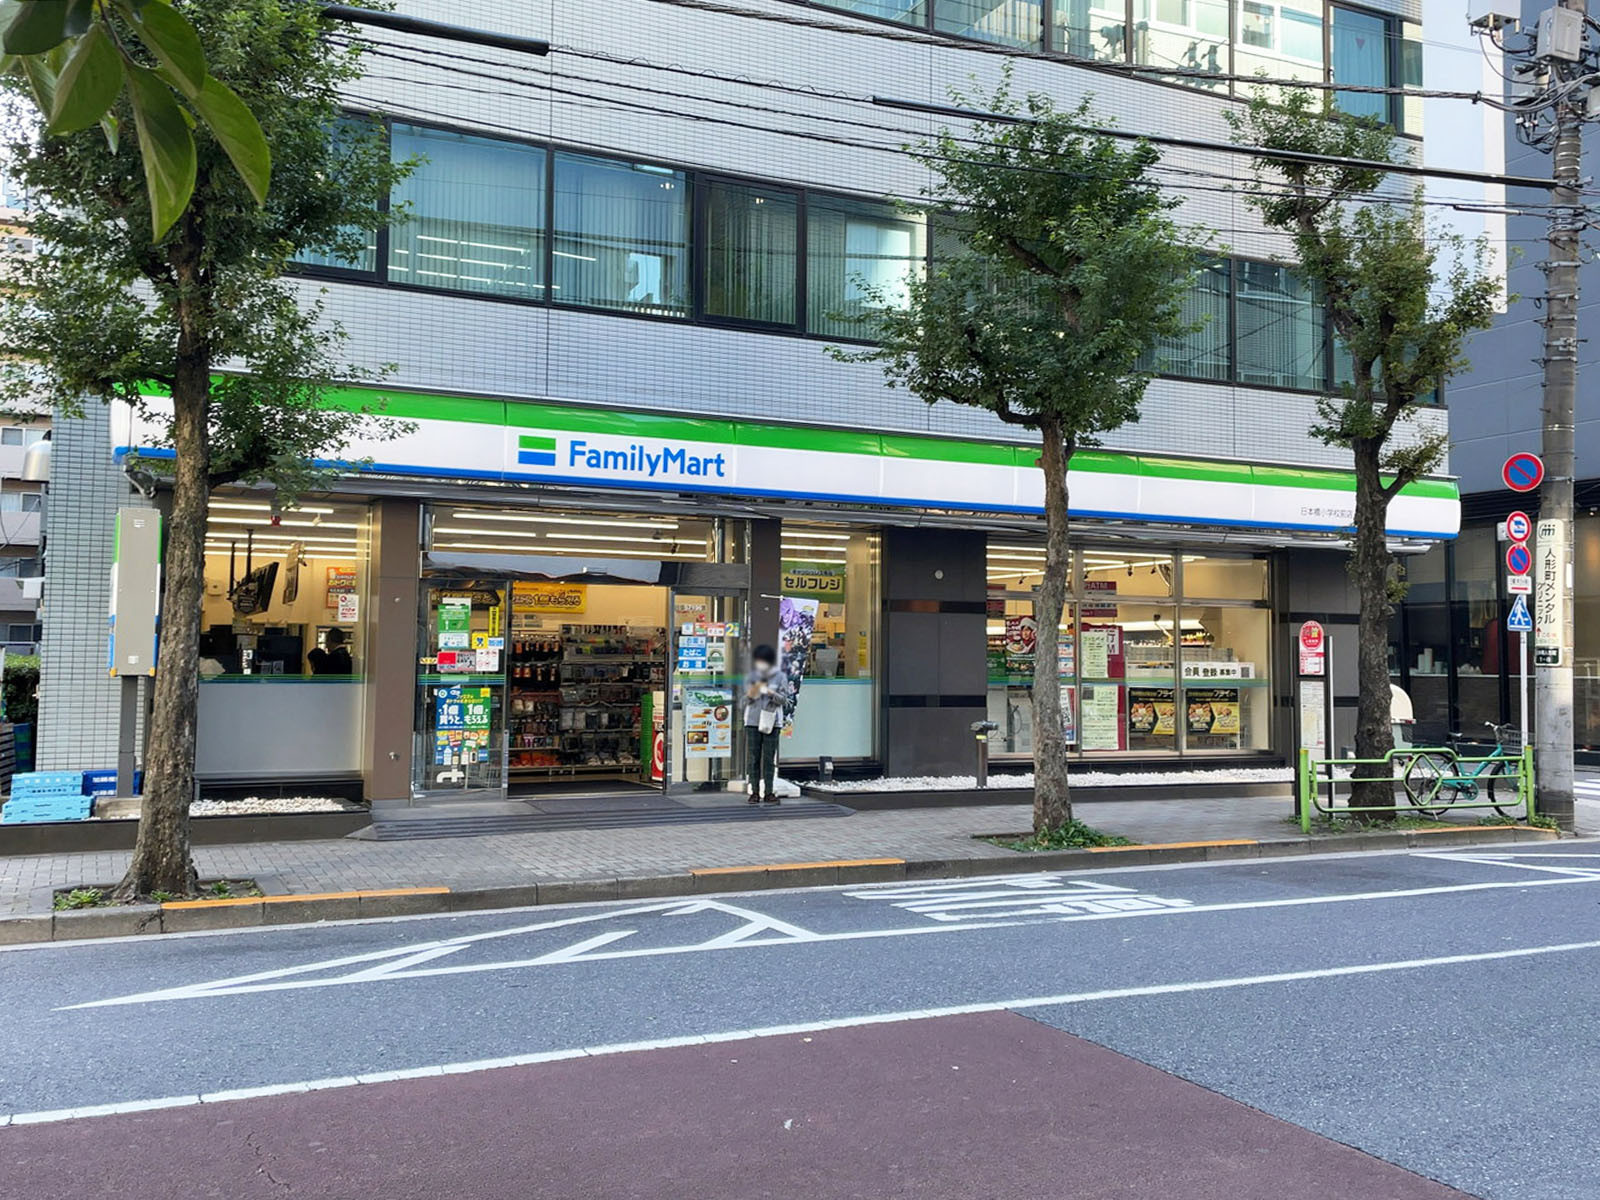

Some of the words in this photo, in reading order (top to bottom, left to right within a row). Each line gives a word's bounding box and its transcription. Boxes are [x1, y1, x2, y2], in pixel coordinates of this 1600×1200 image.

[569, 440, 725, 477] FamilyMart
[784, 576, 841, 591] セルフレジ
[1545, 547, 1556, 624] 人形町メンタル
[1184, 666, 1200, 677] 会員
